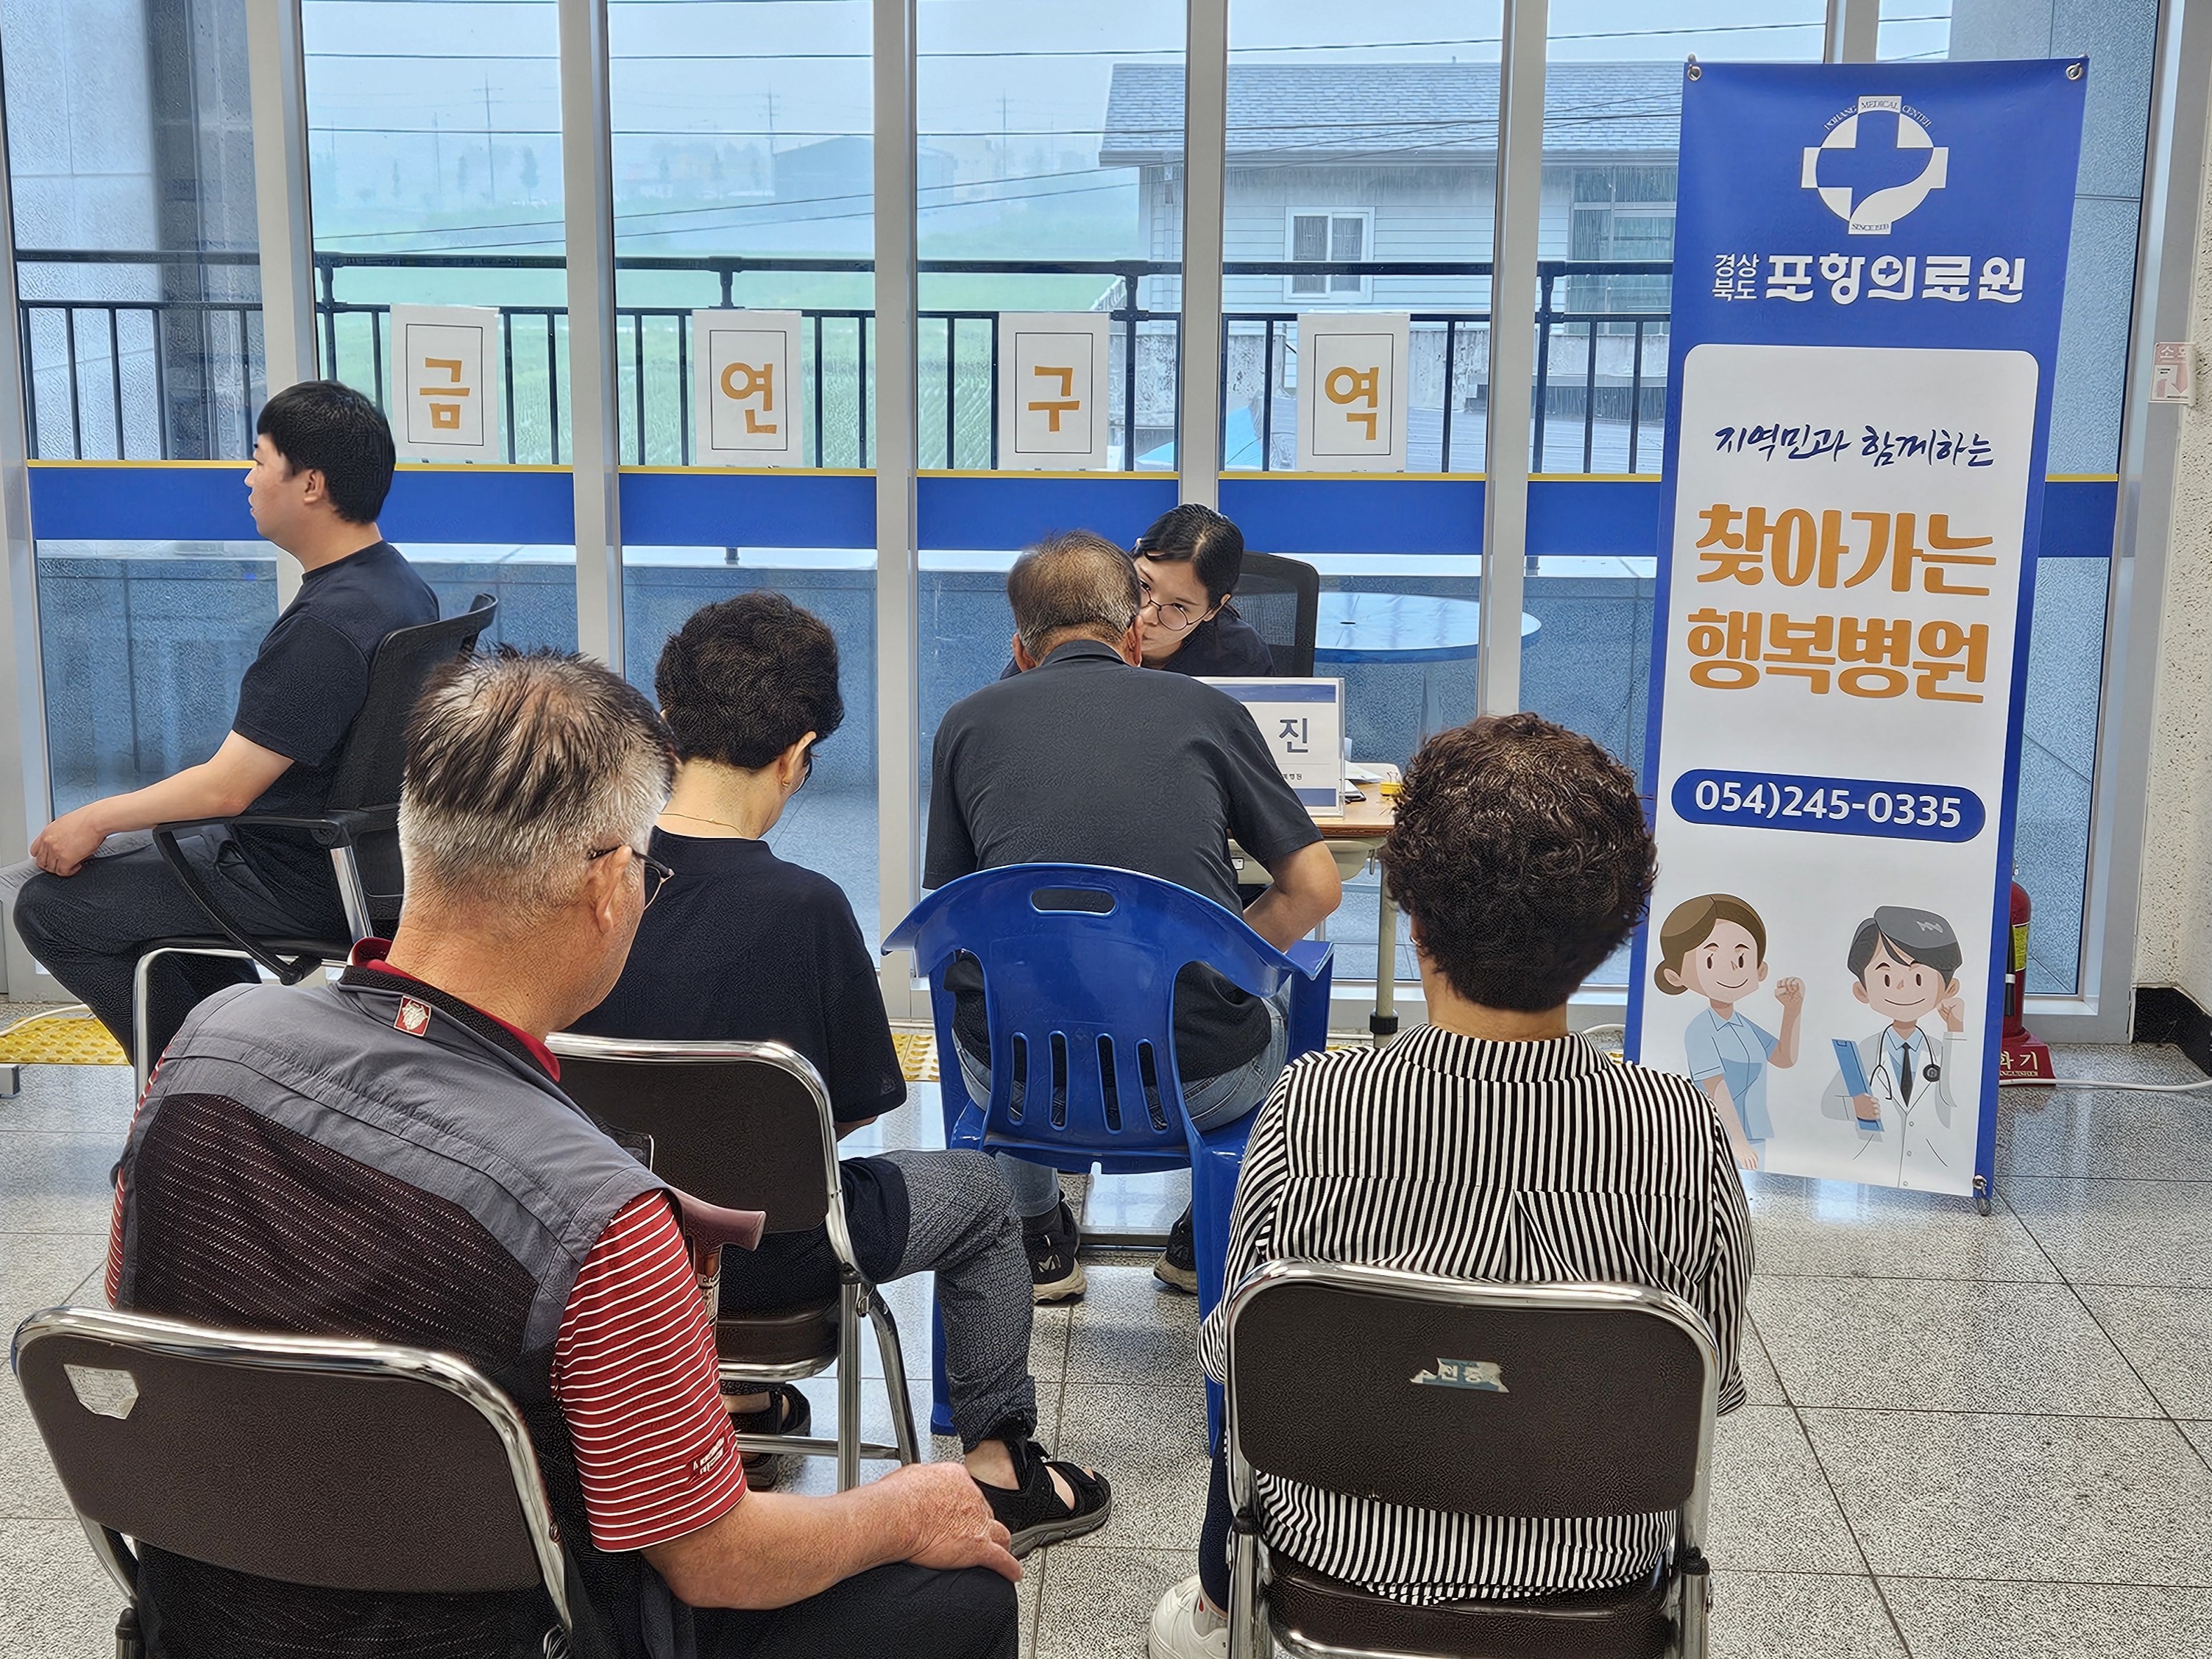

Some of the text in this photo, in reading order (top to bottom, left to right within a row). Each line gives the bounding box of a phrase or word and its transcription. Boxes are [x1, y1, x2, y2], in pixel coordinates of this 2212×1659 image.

[1861, 100, 1899, 110] MEDICAL
[1715, 253, 1759, 277] 경상
[1765, 253, 2025, 305] 포항의료원
[1712, 278, 1757, 302] 북도
[419, 358, 1380, 441] 금 연 구 역
[1715, 423, 1995, 467] 지역민과 함께하는
[1695, 503, 1996, 596] 찾아가는
[1687, 608, 1989, 703] 행복병원
[1695, 780, 1962, 829] 054)245-0335
